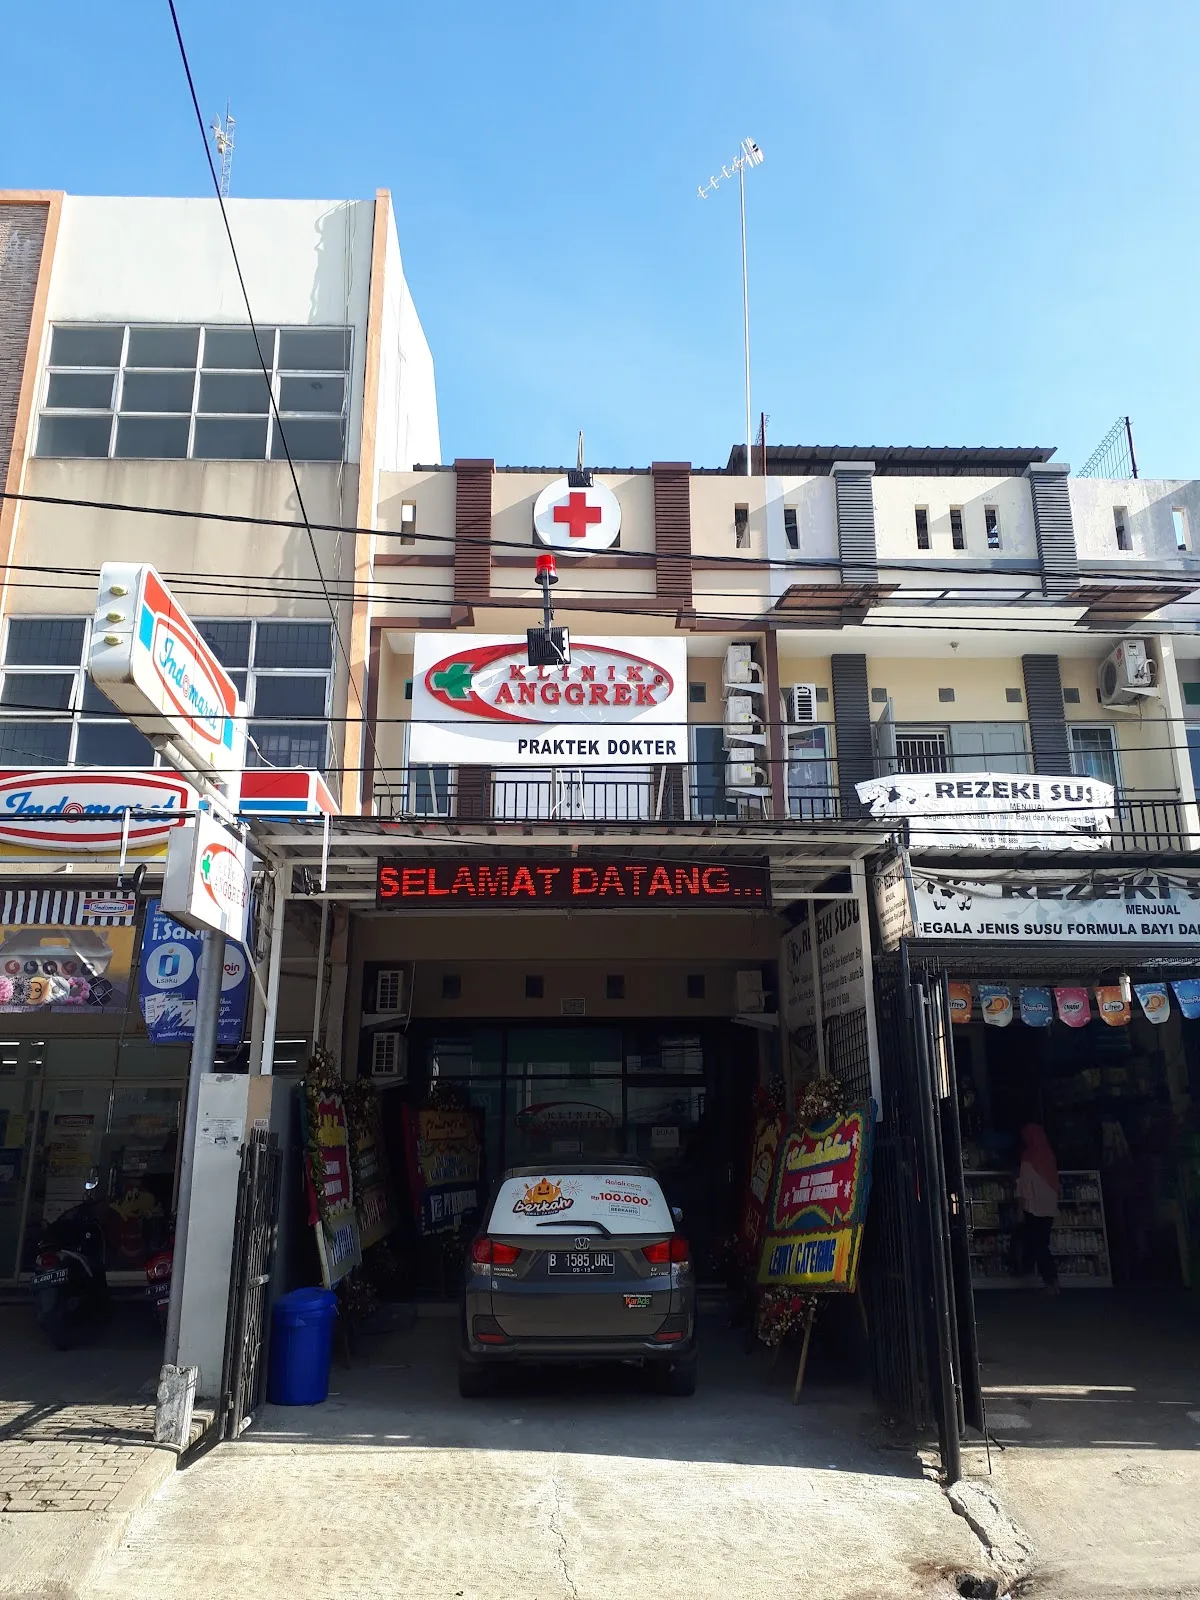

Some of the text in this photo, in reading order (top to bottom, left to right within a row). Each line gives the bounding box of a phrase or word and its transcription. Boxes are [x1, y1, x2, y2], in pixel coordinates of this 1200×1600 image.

[509, 664, 643, 682] KLINIK
[159, 637, 219, 731] Indomaret
[494, 682, 658, 707] ANGGREK
[517, 739, 677, 756] PRAKTEK DOKTER
[935, 781, 1040, 801] REZEKI
[5, 791, 176, 824] Indomaret
[380, 866, 561, 897] SELAMAT
[1001, 878, 1172, 902] REZEKI
[1126, 904, 1181, 916] MENJUAL
[976, 922, 1019, 936] JENIS
[1024, 922, 1063, 937] SUSU
[1067, 923, 1138, 938] FORMULA
[1142, 924, 1173, 938] BAYI
[223, 962, 240, 972] oin
[156, 977, 179, 985] i.saku
[950, 1001, 964, 1010] ifree
[1104, 1001, 1122, 1011] Lifree
[547, 1111, 602, 1120] KLINIK
[605, 1178, 642, 1190] Ralali.com
[513, 1197, 574, 1213] berkah
[550, 1254, 614, 1267] B 1585 URL
[625, 1296, 650, 1305] KarAds
